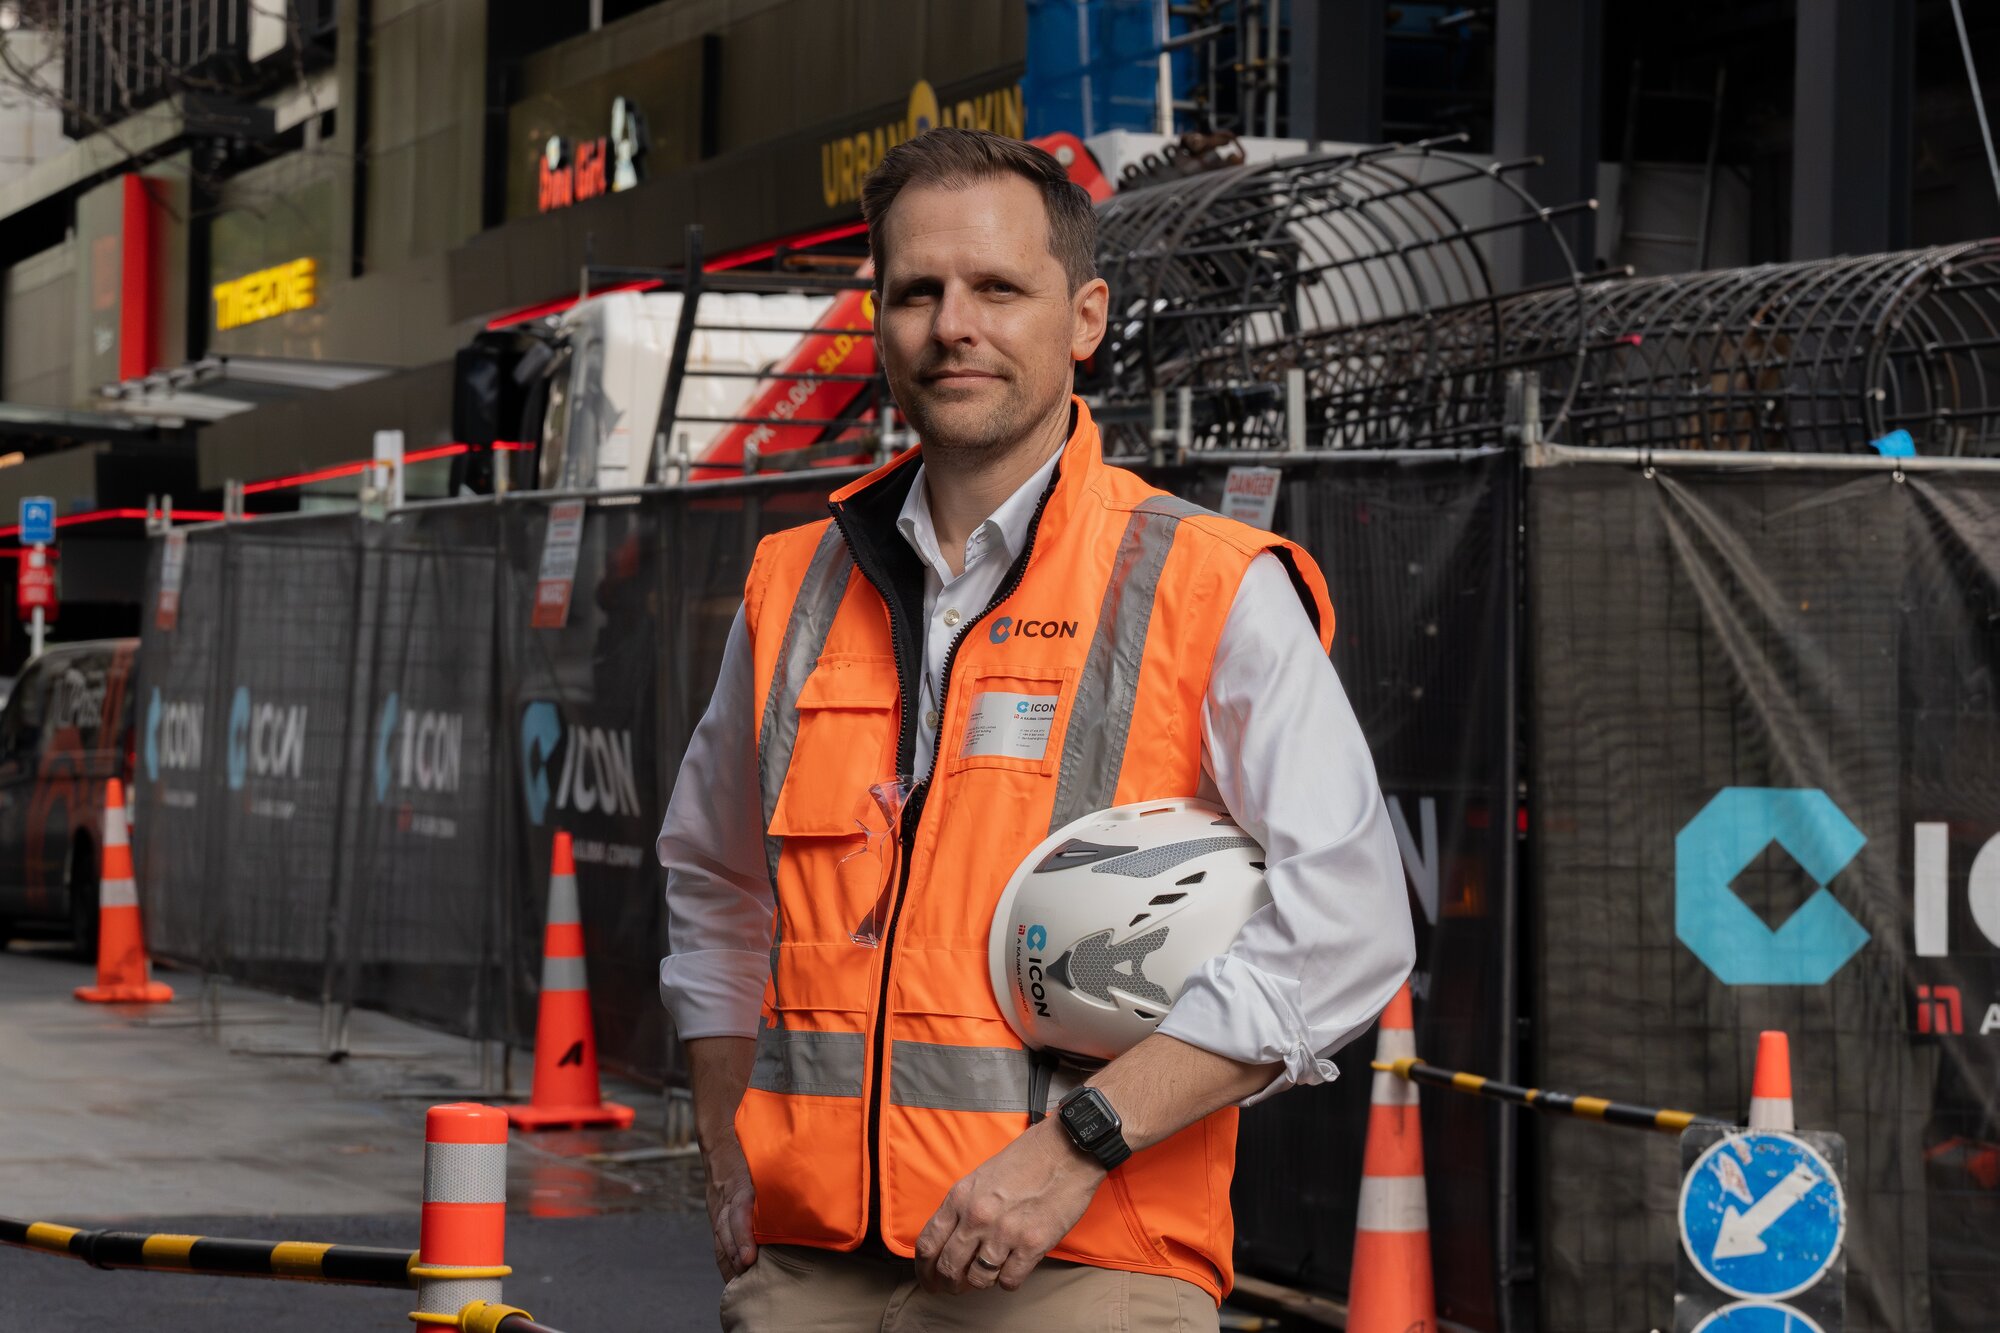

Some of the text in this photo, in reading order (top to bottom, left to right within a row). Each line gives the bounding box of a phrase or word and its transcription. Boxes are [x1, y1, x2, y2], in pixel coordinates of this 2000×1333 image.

[213, 257, 316, 331] TIMEZONE
[1228, 474, 1275, 497] DANGER
[1014, 619, 1079, 639] ICON
[160, 702, 205, 771] ICON
[250, 702, 308, 778] ICON
[1030, 703, 1057, 713] ICON
[401, 709, 463, 792] ICON
[556, 724, 641, 818] ICON
[1028, 957, 1051, 1018] ICON
